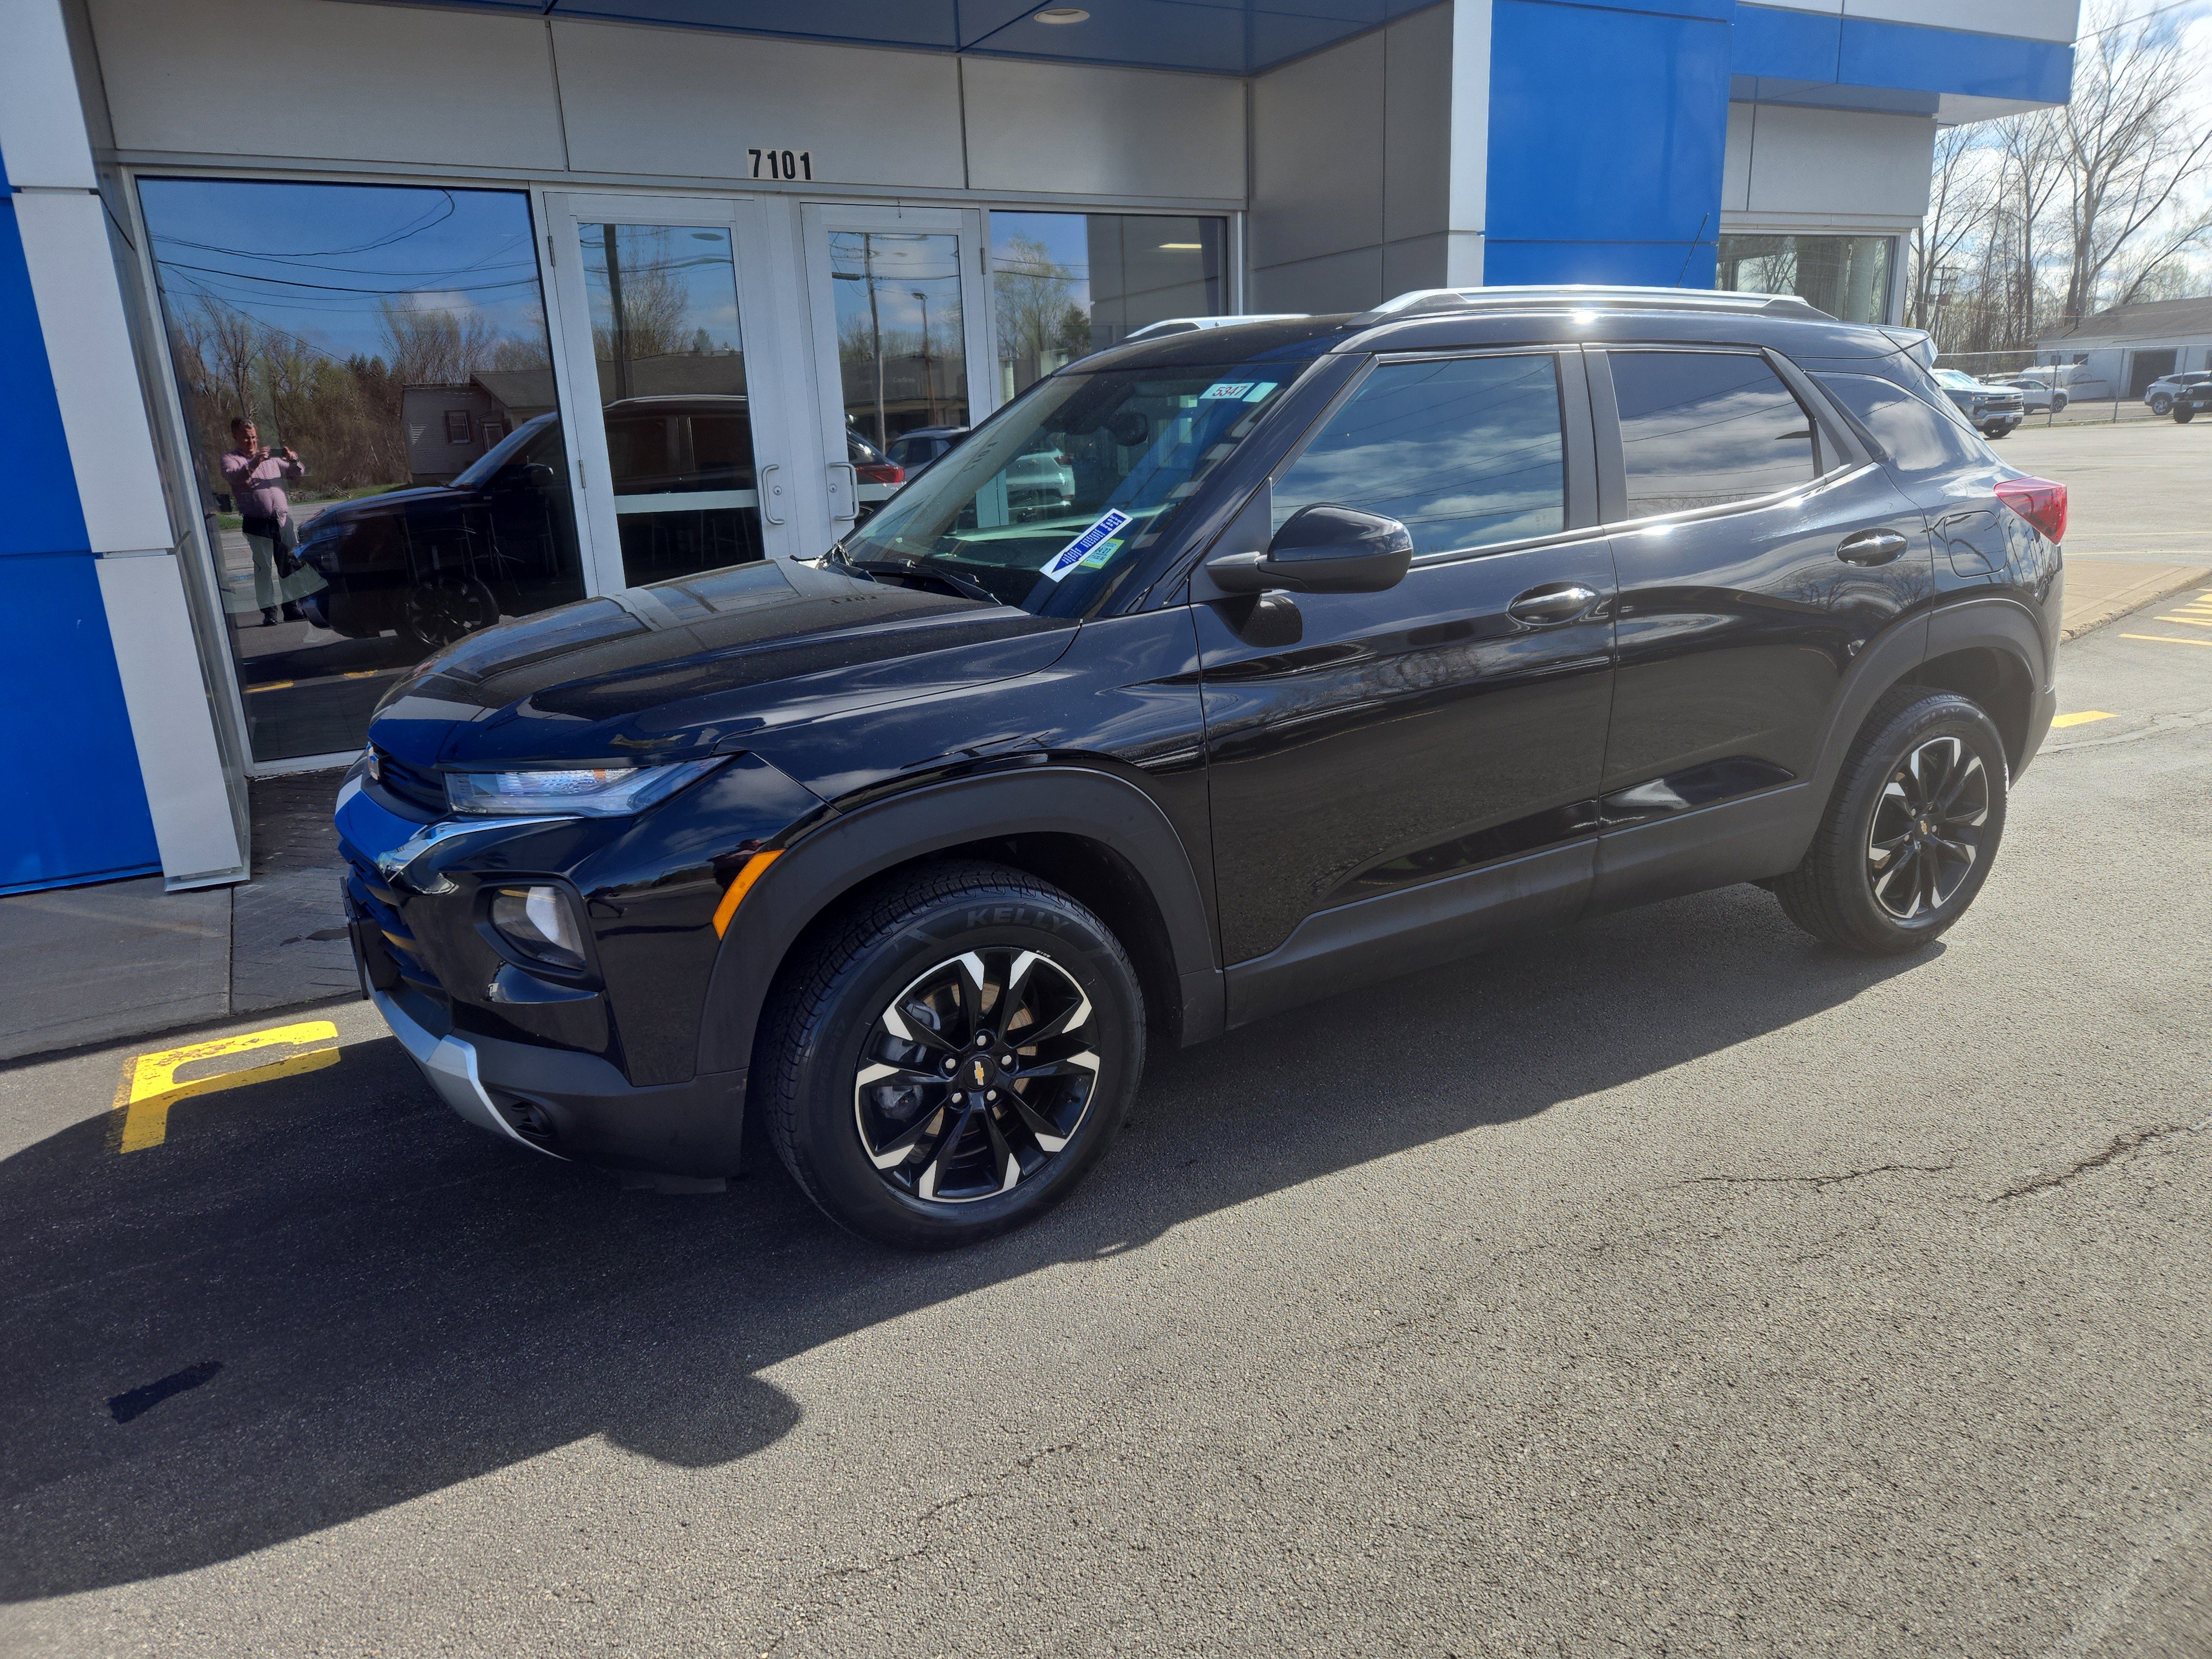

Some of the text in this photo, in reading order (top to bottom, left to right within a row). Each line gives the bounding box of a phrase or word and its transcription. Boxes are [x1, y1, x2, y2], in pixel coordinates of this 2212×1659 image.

[748, 149, 811, 180] 7101
[1212, 385, 1248, 396] 5347
[967, 907, 1070, 933] KELLY
